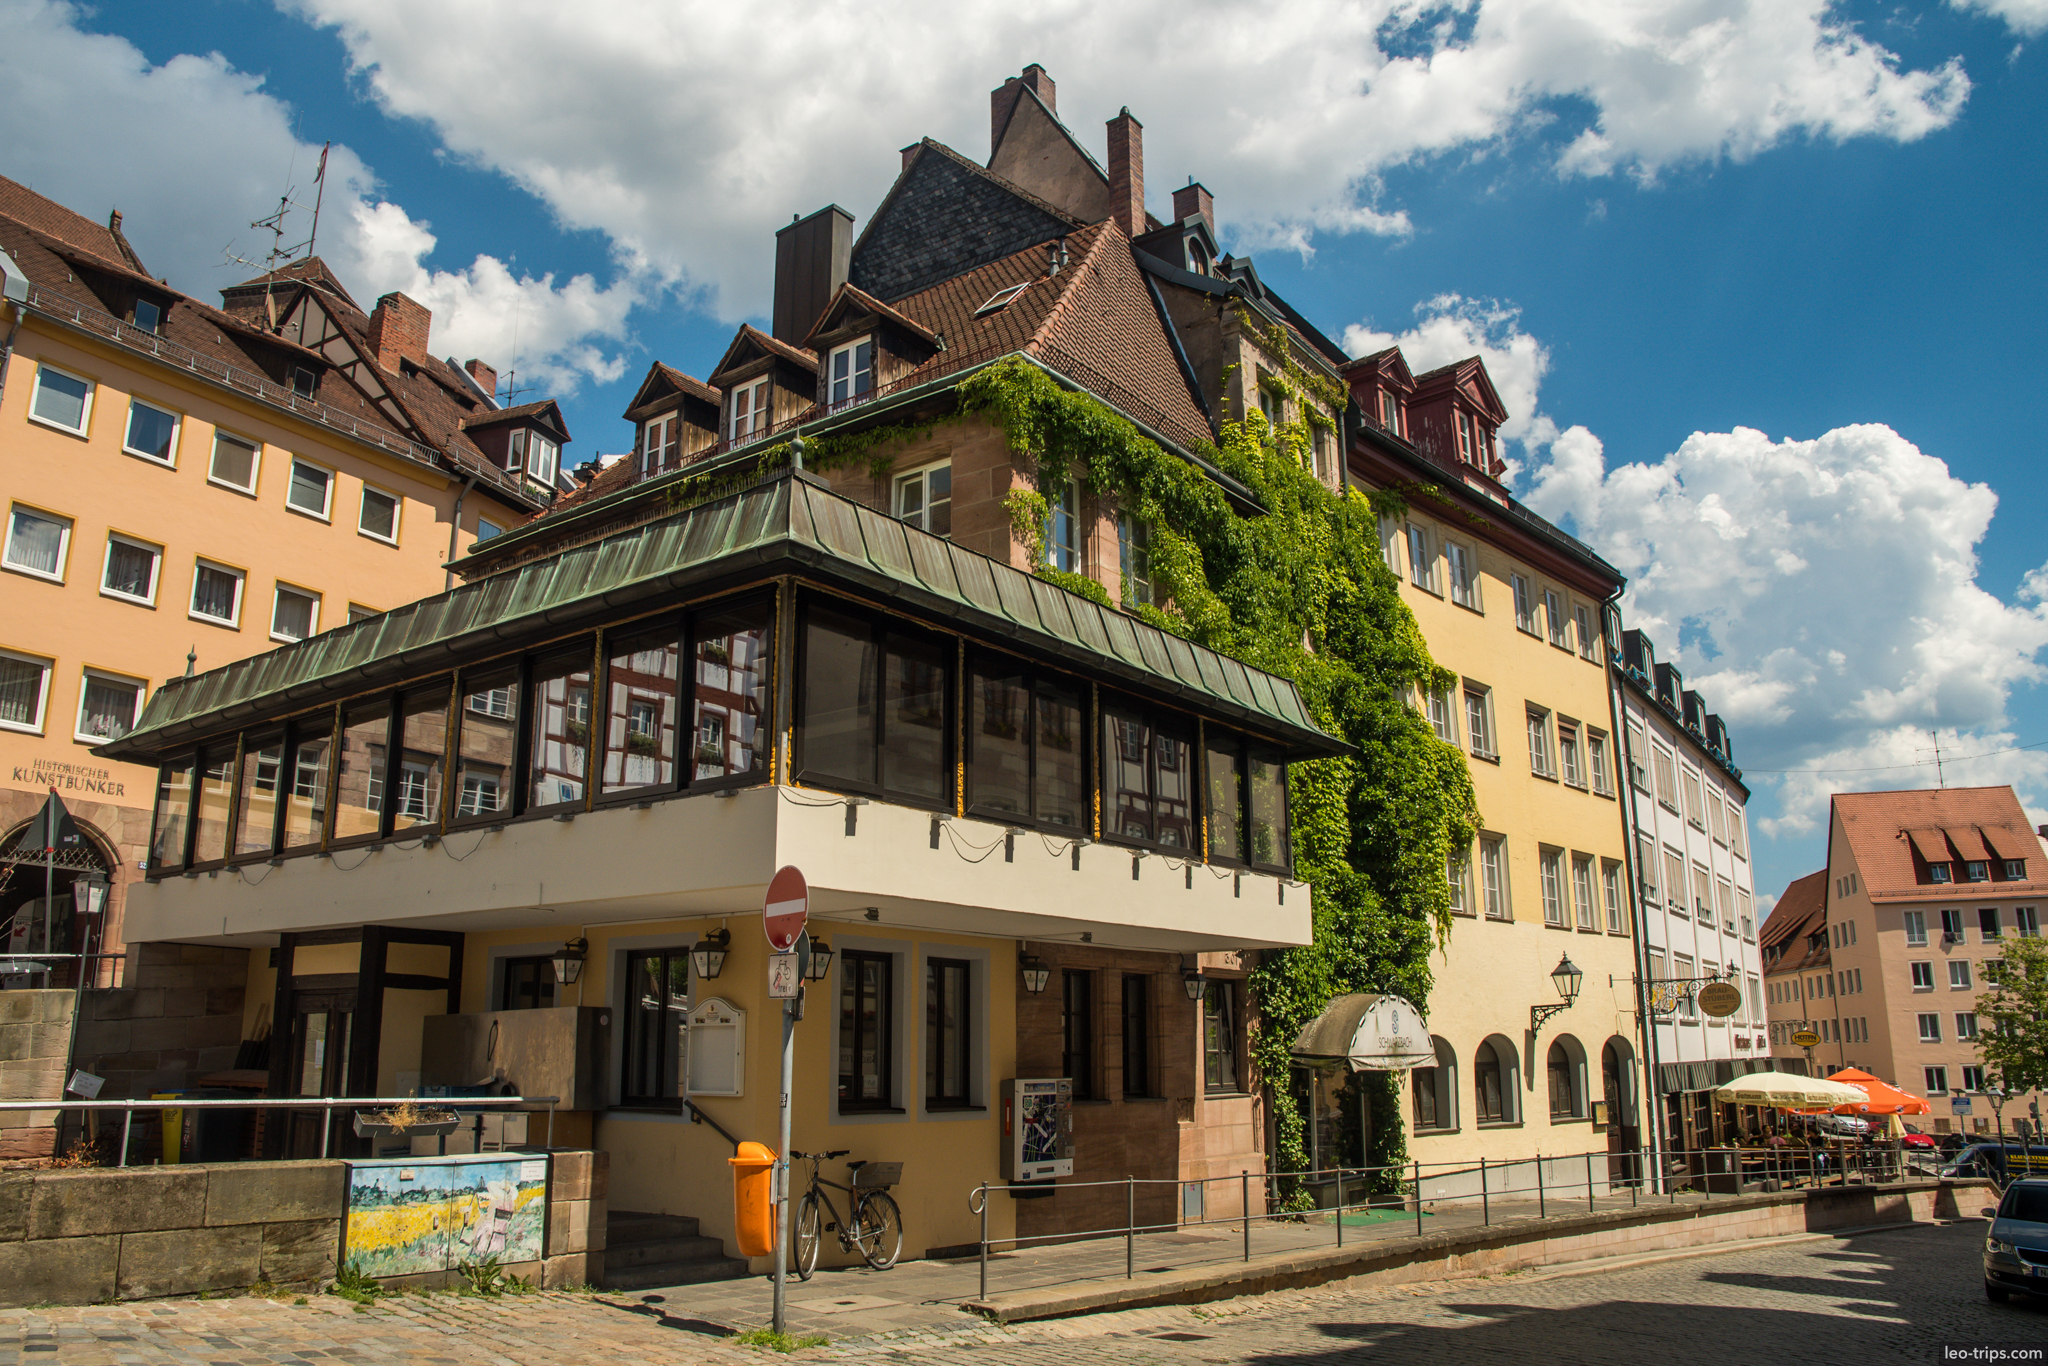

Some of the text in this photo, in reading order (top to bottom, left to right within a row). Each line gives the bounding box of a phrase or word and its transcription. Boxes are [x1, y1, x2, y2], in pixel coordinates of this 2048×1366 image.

[33, 758, 110, 780] HISTORISCHER
[12, 767, 125, 797] KUNSTBUNKER
[1707, 986, 1730, 995] BRAU-
[1702, 994, 1737, 1002] STÜBERL
[1378, 1036, 1412, 1048] SCHWARZBACH
